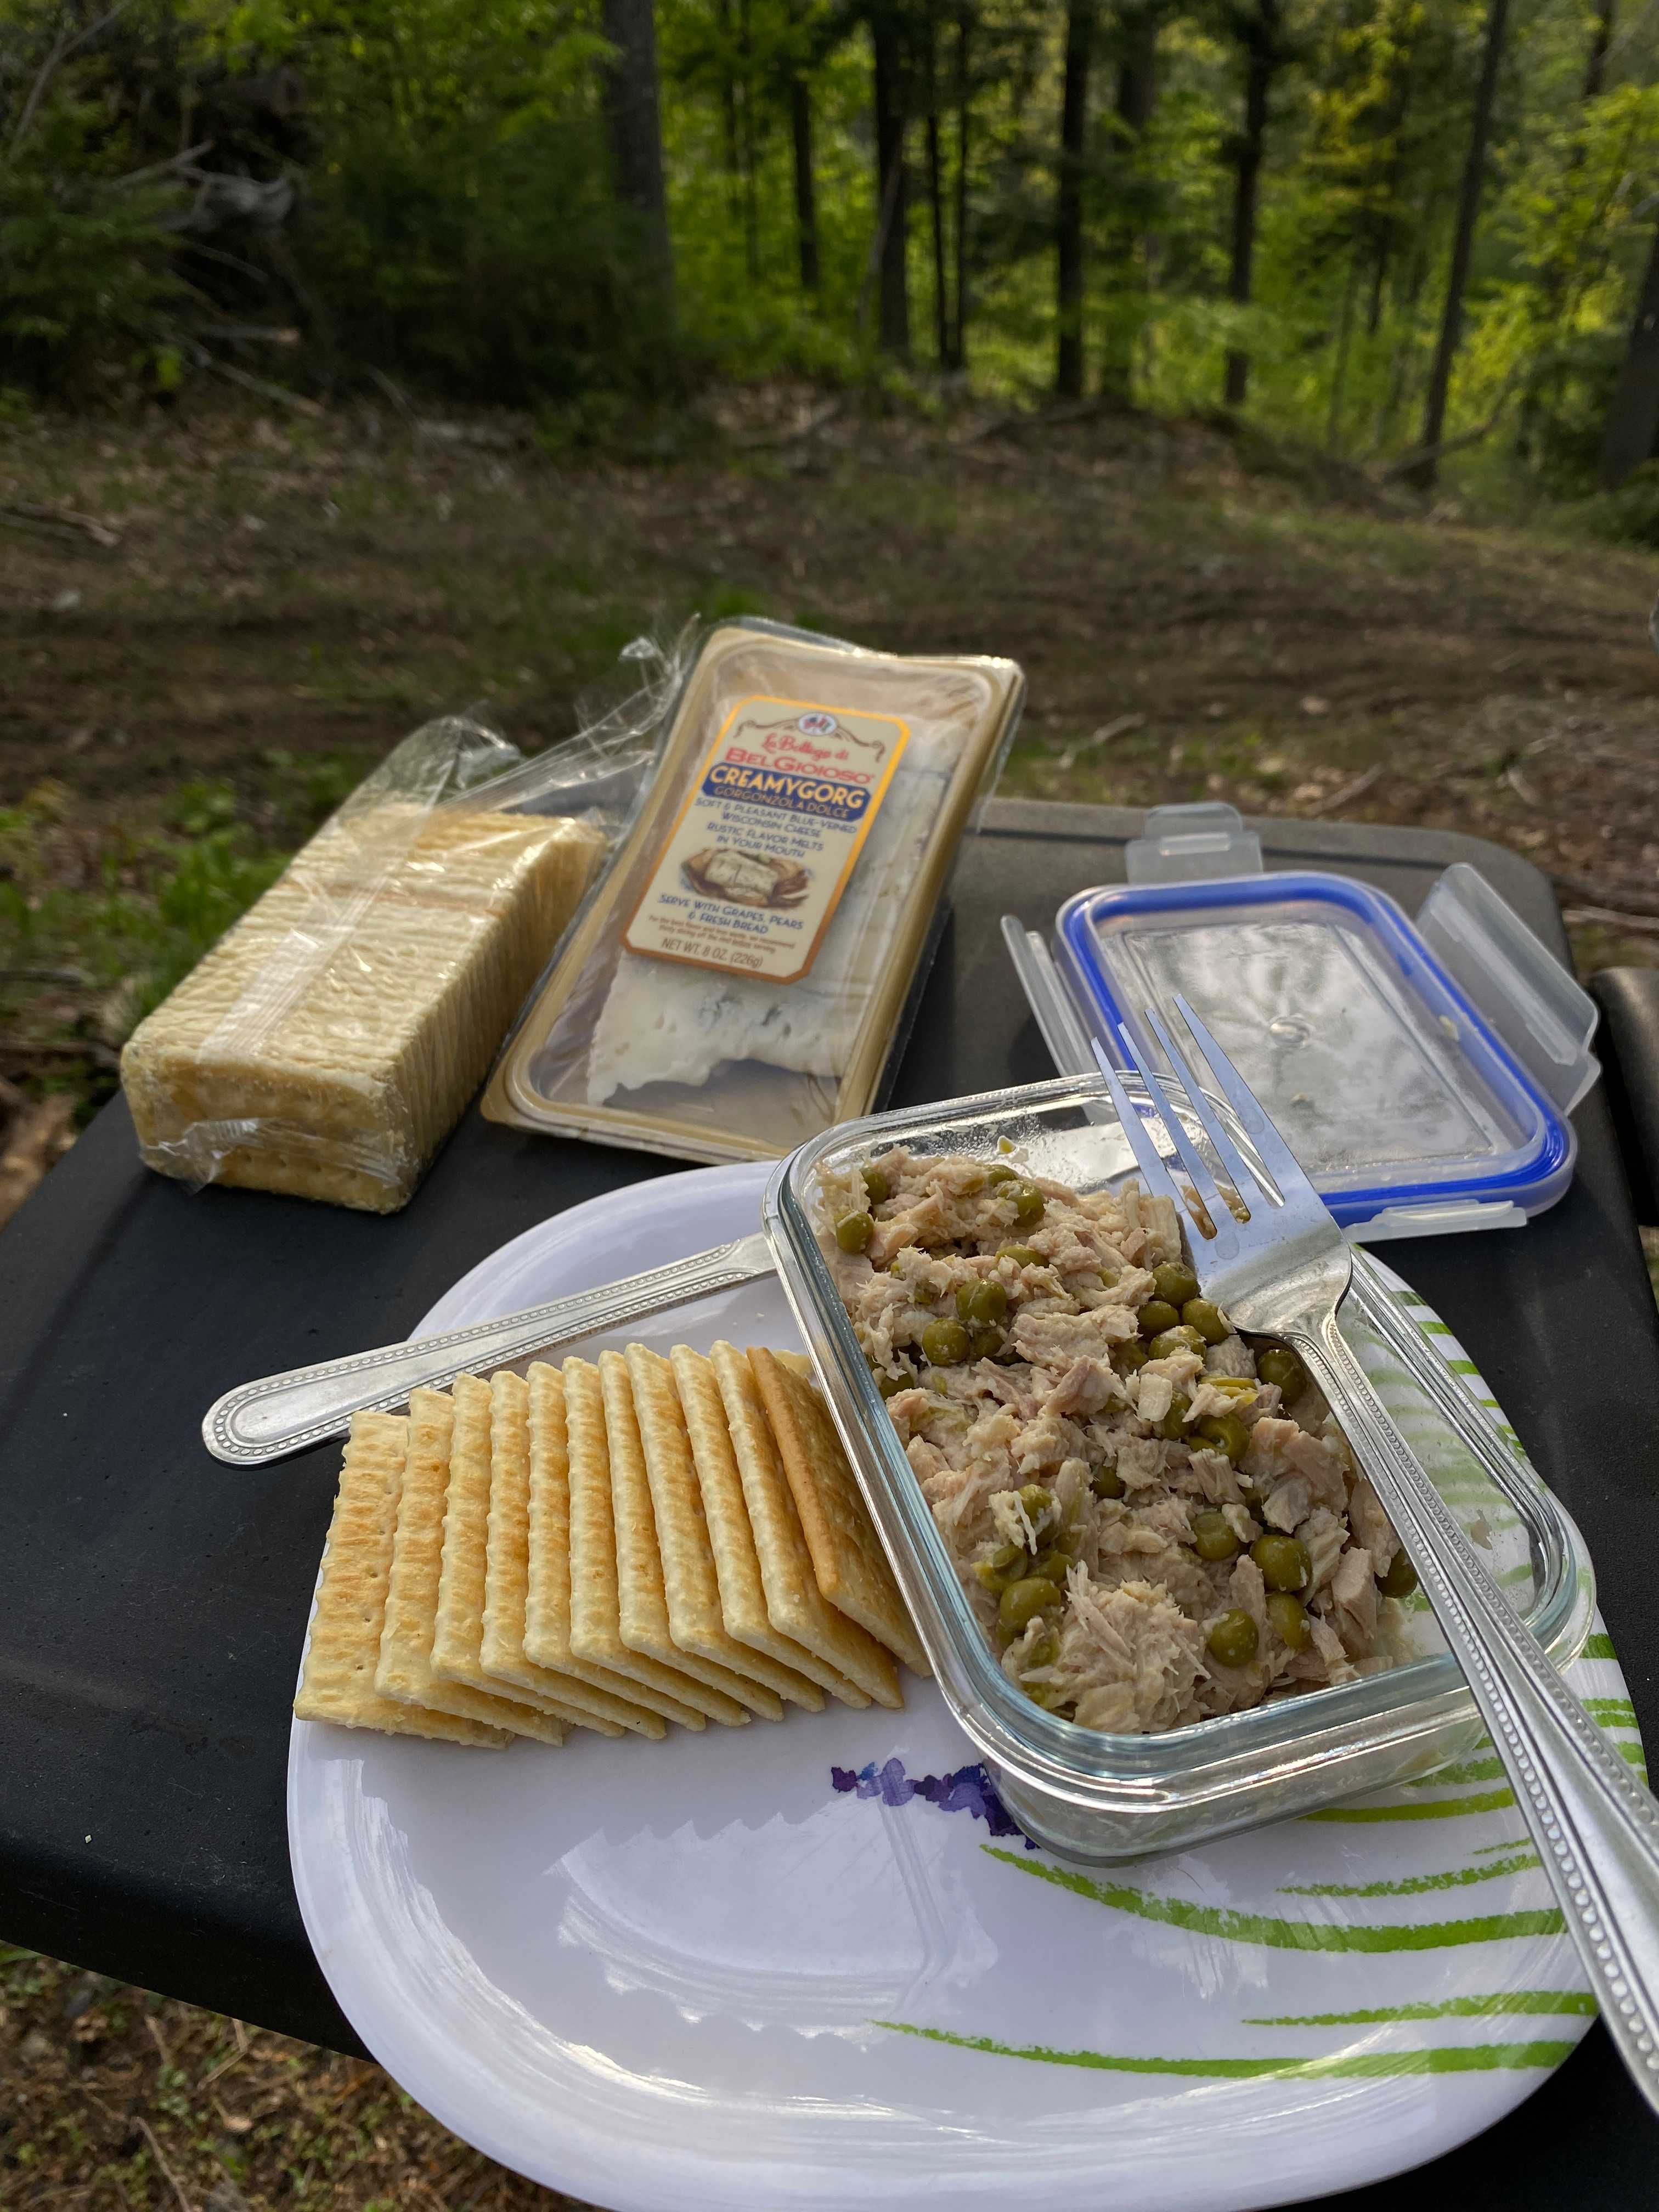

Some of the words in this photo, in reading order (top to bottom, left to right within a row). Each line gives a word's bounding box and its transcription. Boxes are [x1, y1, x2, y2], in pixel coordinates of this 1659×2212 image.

[710, 765, 865, 809] CREAMYGORG
[715, 786, 804, 809] GORGONZOLA
[806, 802, 850, 819] DOLCE
[734, 804, 787, 820] PLEASANT
[707, 822, 743, 836] RUSTIC
[747, 829, 788, 843] FLAVOR
[791, 838, 823, 851] MELTS
[784, 823, 822, 838] CHEESE
[716, 835, 729, 844] IN
[732, 837, 763, 850] YOUR
[765, 843, 806, 858] MOUTH
[659, 895, 691, 908] SERVE
[694, 900, 720, 913] WITH
[770, 915, 804, 930] PEARS
[699, 913, 731, 927] FRESH
[733, 920, 769, 934] BREAD
[661, 938, 683, 950] NET
[702, 946, 709, 956] 8
[730, 951, 764, 968] (226g)
